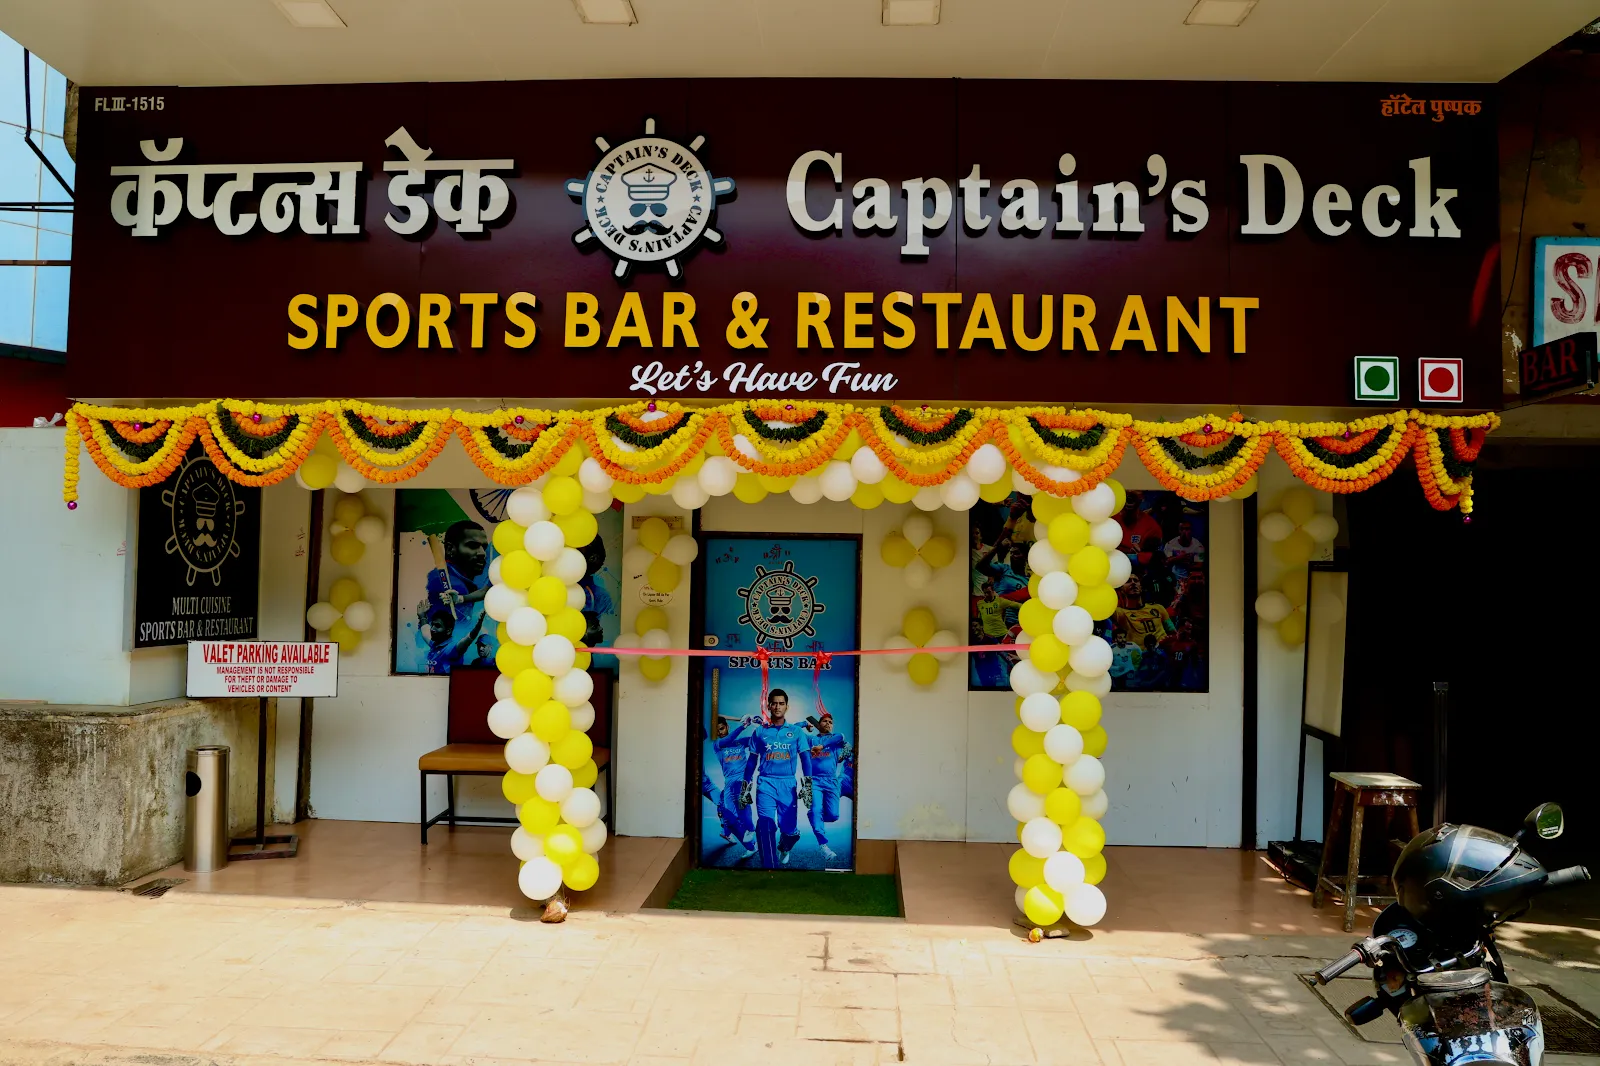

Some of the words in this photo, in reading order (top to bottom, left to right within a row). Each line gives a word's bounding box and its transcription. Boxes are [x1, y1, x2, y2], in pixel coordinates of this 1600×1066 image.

[1430, 99, 1482, 123] पुष्पक
[110, 137, 363, 237] कॅप्टन्स
[383, 125, 515, 235] डेक
[595, 145, 669, 193] CAPTAIN'S
[671, 152, 703, 193] DECK
[786, 150, 1209, 255] Captain's
[1240, 154, 1462, 238] Deck
[594, 207, 627, 246] DECK
[628, 205, 703, 253] CAPTAIN'S
[287, 291, 537, 350] SPORTS
[564, 291, 700, 348] BAR
[725, 291, 770, 350] &
[796, 291, 1260, 354] RESTAURANT
[1521, 338, 1579, 386] BAR
[629, 360, 719, 395] Let's
[722, 361, 819, 394] Have
[821, 361, 899, 395] Fun
[171, 596, 200, 616] MULTI
[200, 596, 232, 615] CUISINE
[985, 606, 993, 615] 10
[140, 620, 176, 642] SPORTS
[177, 619, 195, 639] BAR
[196, 619, 203, 638] &
[204, 616, 254, 637] RESTAURANT
[1141, 619, 1157, 633] 10
[202, 643, 234, 663] VALET
[237, 643, 278, 663] PARKING
[281, 644, 330, 663] AVAILABLE
[216, 666, 256, 675] MANAGEMENT
[257, 666, 263, 675] IS
[264, 666, 276, 675] NOT
[277, 666, 315, 674] RESPONSIBLE
[224, 675, 236, 683] FOR
[238, 675, 255, 683] THEFT
[256, 675, 265, 683] OR
[265, 675, 289, 683] DAMAGE
[290, 675, 298, 683] TO
[227, 684, 255, 693] VEHICLES
[256, 684, 265, 693] OR
[265, 684, 292, 693] CONTENT
[765, 751, 791, 760] INDIA
[773, 741, 791, 750] Star
